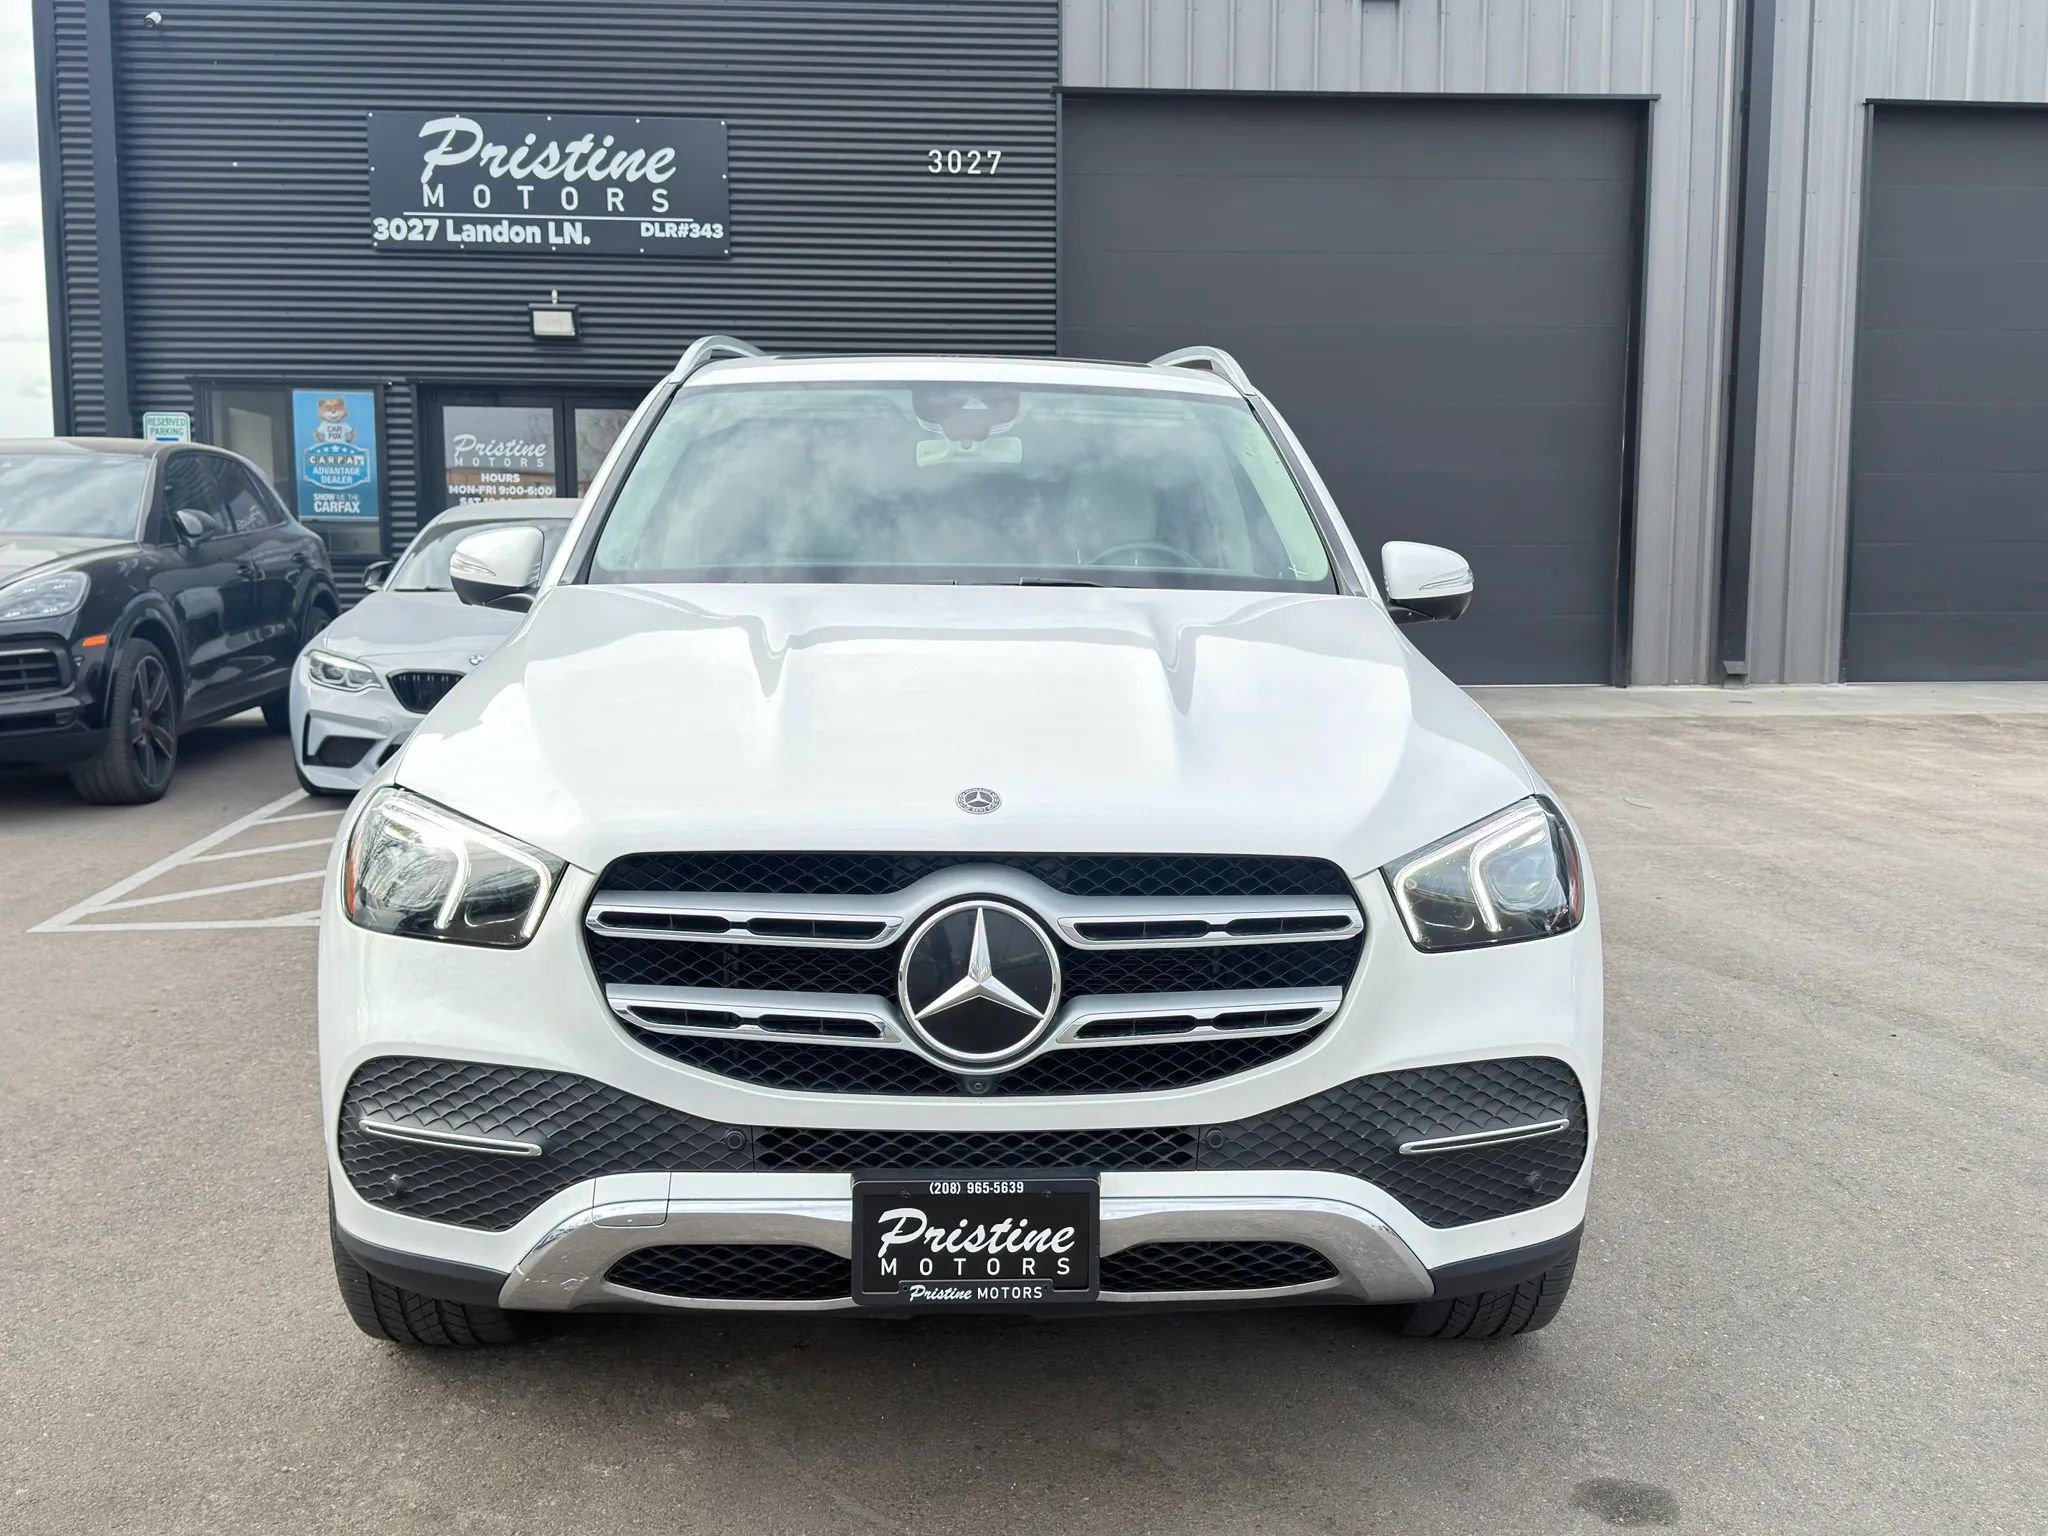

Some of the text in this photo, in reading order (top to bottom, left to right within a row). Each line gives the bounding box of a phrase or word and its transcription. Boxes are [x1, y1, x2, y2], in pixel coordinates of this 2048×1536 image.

[418, 117, 677, 184] Pristine
[928, 149, 1002, 175] 3027
[422, 184, 669, 214] MOTORS
[373, 217, 724, 245] 3027 Landon LN. DLR#343
[147, 416, 186, 427] RESERVED
[150, 427, 184, 437] PARKING
[453, 434, 546, 457] Pristine
[309, 455, 364, 466] CARFAX
[455, 457, 544, 467] MOTORS
[312, 466, 361, 476] ADVANTAGE
[320, 475, 353, 484] DEALER
[481, 473, 521, 483] HOURS
[448, 484, 496, 495] MON-FRI
[313, 493, 335, 501] SHOW
[314, 501, 361, 513] CARFAX
[929, 1181, 1024, 1195] (208) 965-5639
[877, 1207, 1075, 1258] Pristine
[880, 1257, 1071, 1276] MOTORS
[909, 1284, 1043, 1302] Pristine MOTORS
